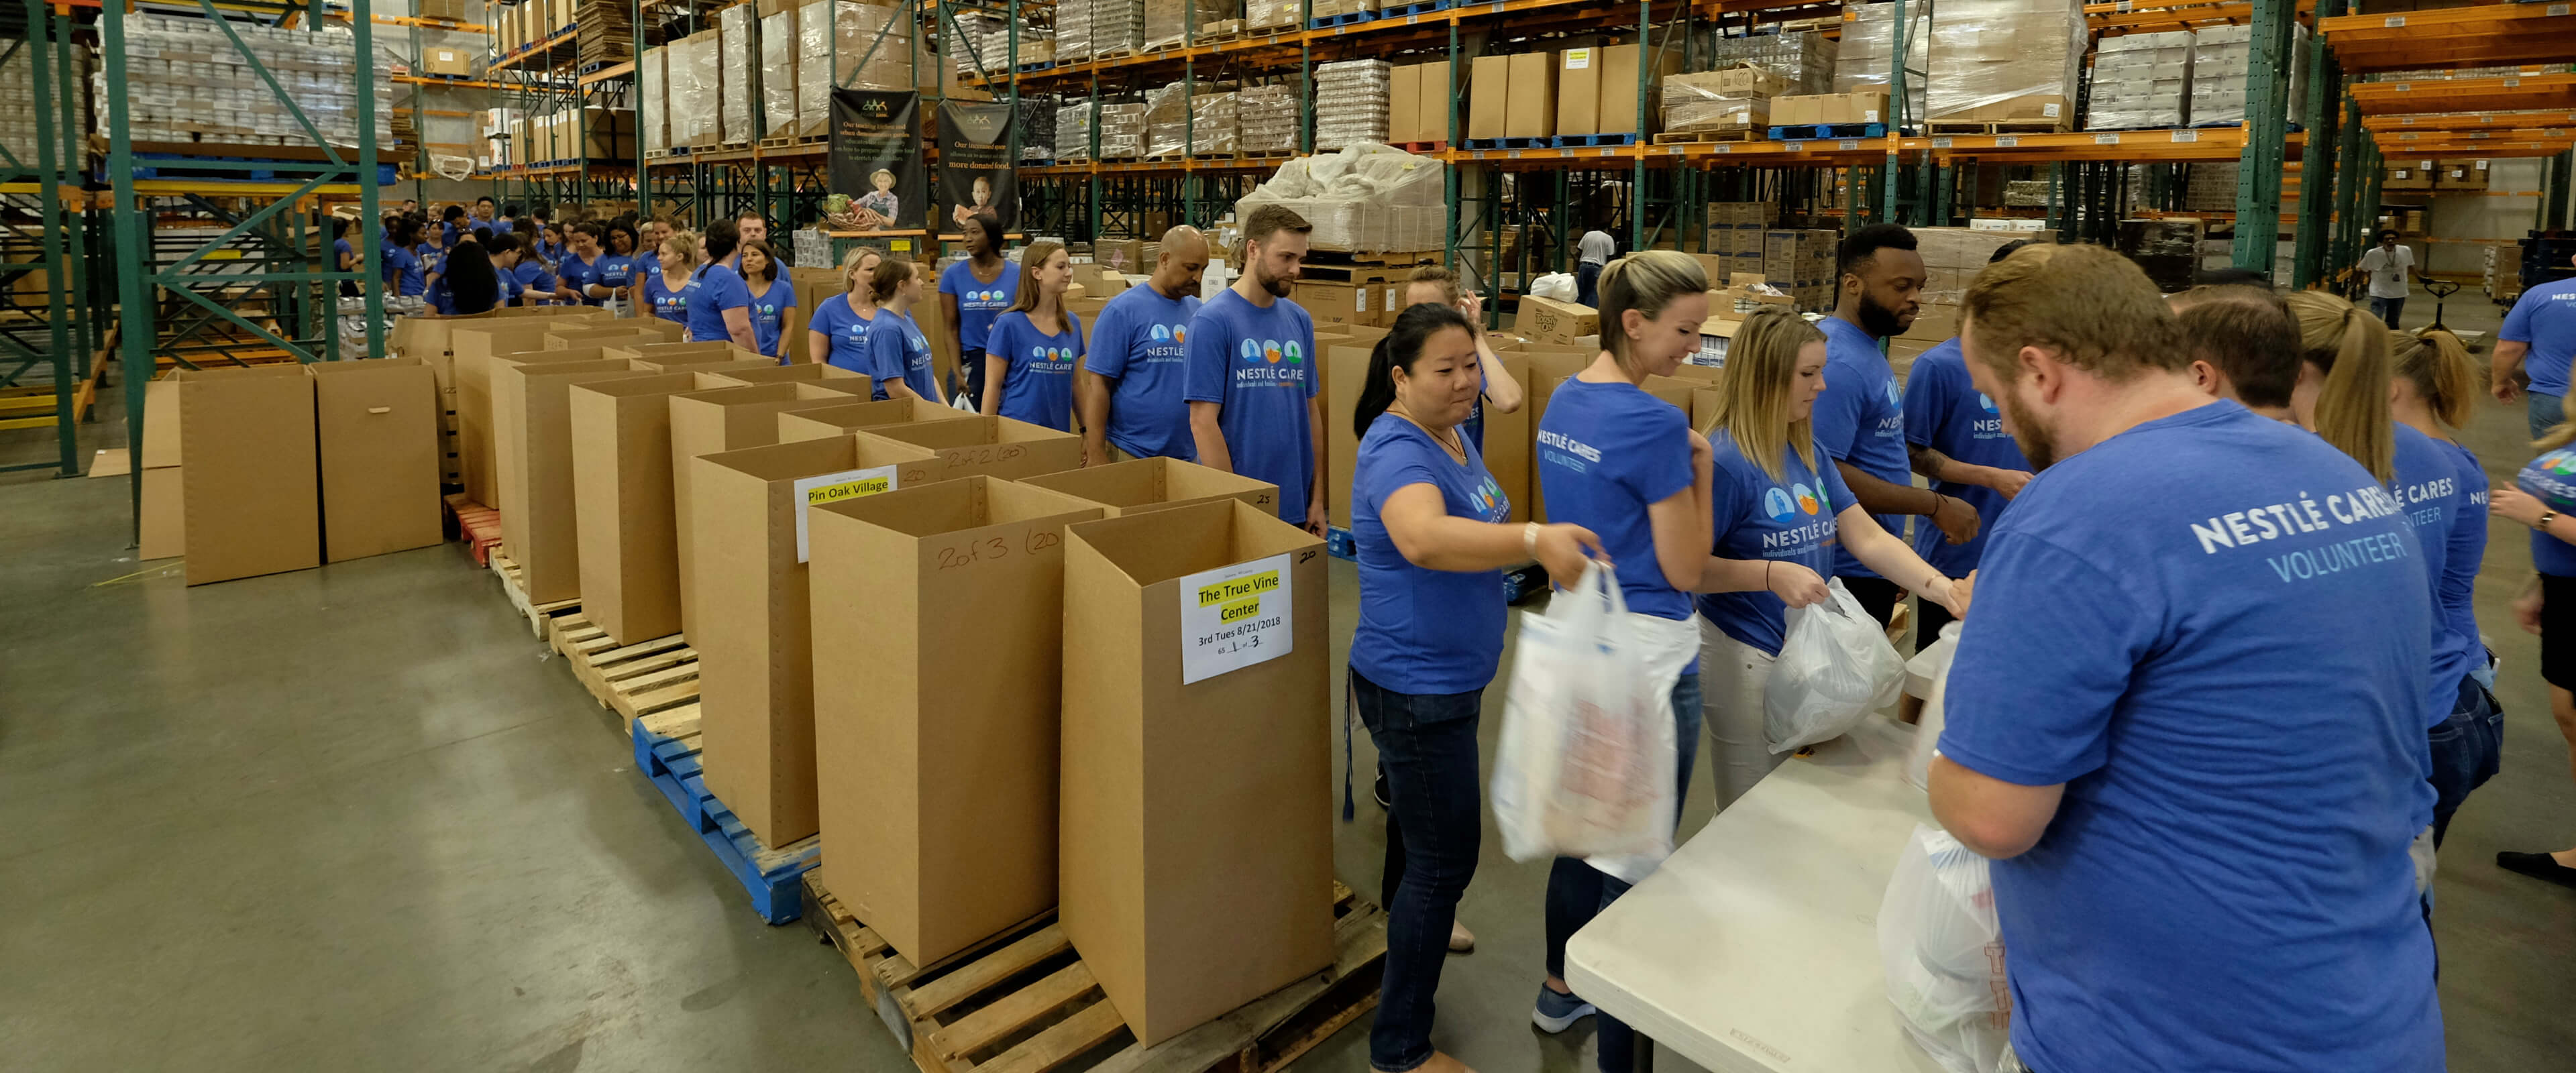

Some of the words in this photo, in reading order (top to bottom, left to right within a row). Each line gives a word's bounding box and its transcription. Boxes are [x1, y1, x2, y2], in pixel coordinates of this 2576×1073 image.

[994, 162, 1011, 170] food.
[1535, 313, 1558, 327] Toasty
[1146, 345, 1184, 357] NESTLÉ
[1030, 361, 1054, 370] NESTLÉ
[1237, 366, 1276, 380] NESTLÉ
[1278, 368, 1305, 380] CARE
[1974, 419, 2002, 431] NES
[1537, 429, 1568, 450] NESTLÉ
[979, 449, 993, 465] 2
[904, 469, 926, 482] 20
[808, 491, 825, 502] Pin
[828, 486, 851, 498] Oak
[853, 480, 889, 494] Village
[1256, 494, 1271, 504] 25
[2408, 477, 2453, 504] CARES
[2190, 491, 2330, 555] NESTLÉ
[2405, 506, 2442, 528] NTEER
[1762, 519, 1819, 549] NESTLÉ
[987, 537, 1008, 559] 3
[1762, 547, 1796, 558] individuals
[2267, 531, 2408, 583] VOLUNTEER
[1299, 551, 1316, 565] 20
[1198, 589, 1221, 604] The
[1224, 583, 1250, 598] True
[1253, 576, 1279, 590] Vine
[1221, 602, 1260, 620] Center
[1198, 634, 1213, 647] 3rd
[1215, 629, 1235, 642] Tues
[1237, 616, 1281, 636] 8/21/2018
[1218, 647, 1226, 655] 65
[1251, 635, 1259, 648] 3
